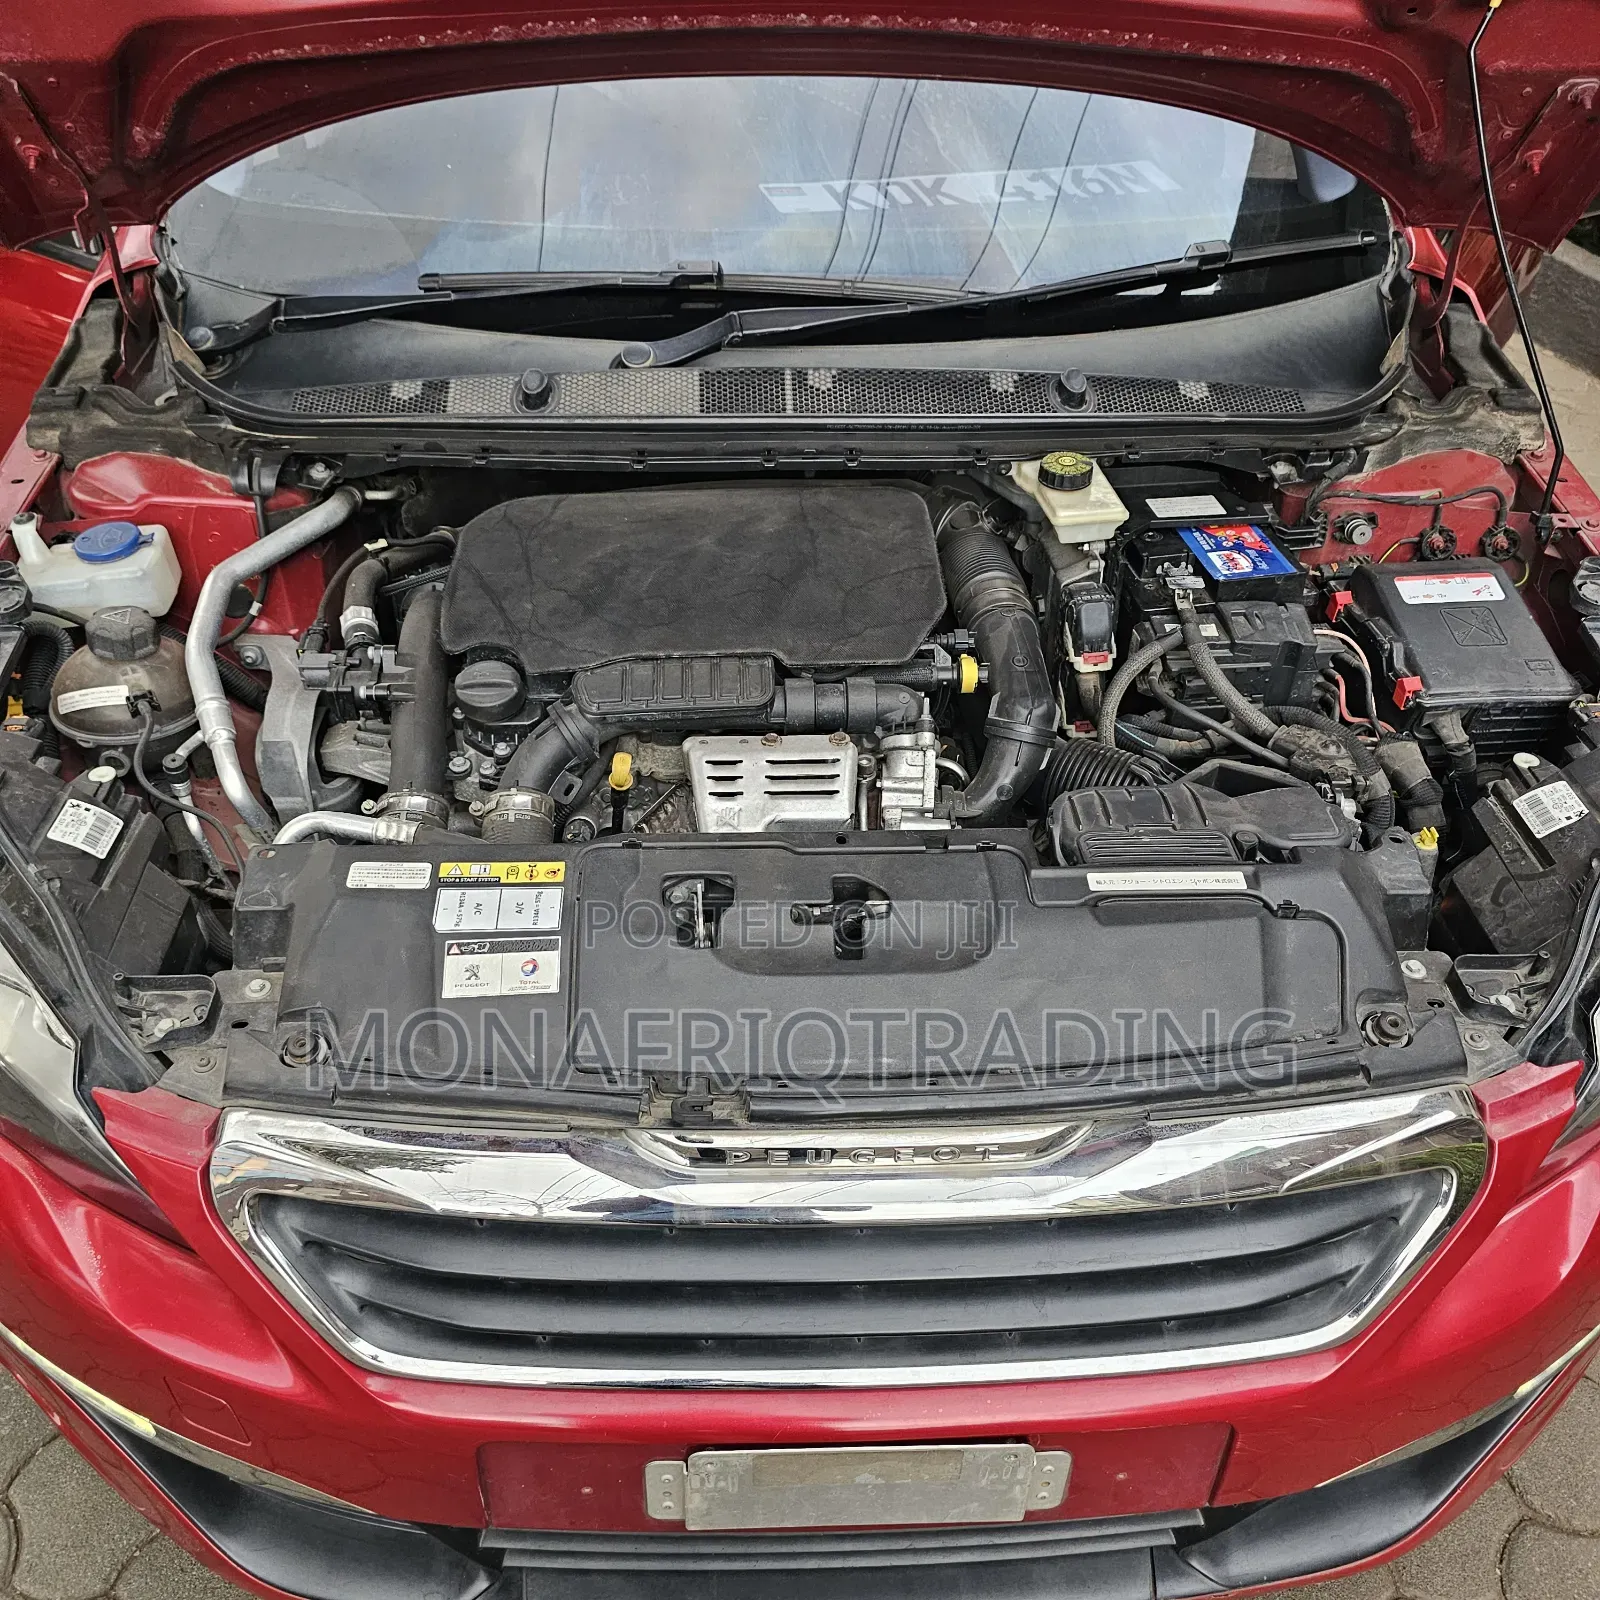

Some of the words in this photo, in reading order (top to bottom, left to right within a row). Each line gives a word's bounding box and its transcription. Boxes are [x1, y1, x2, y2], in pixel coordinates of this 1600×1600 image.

[473, 902, 483, 916] A/C
[515, 901, 525, 915] A/C
[532, 908, 541, 926] R134A
[725, 1144, 1000, 1167] PEUGEOT
